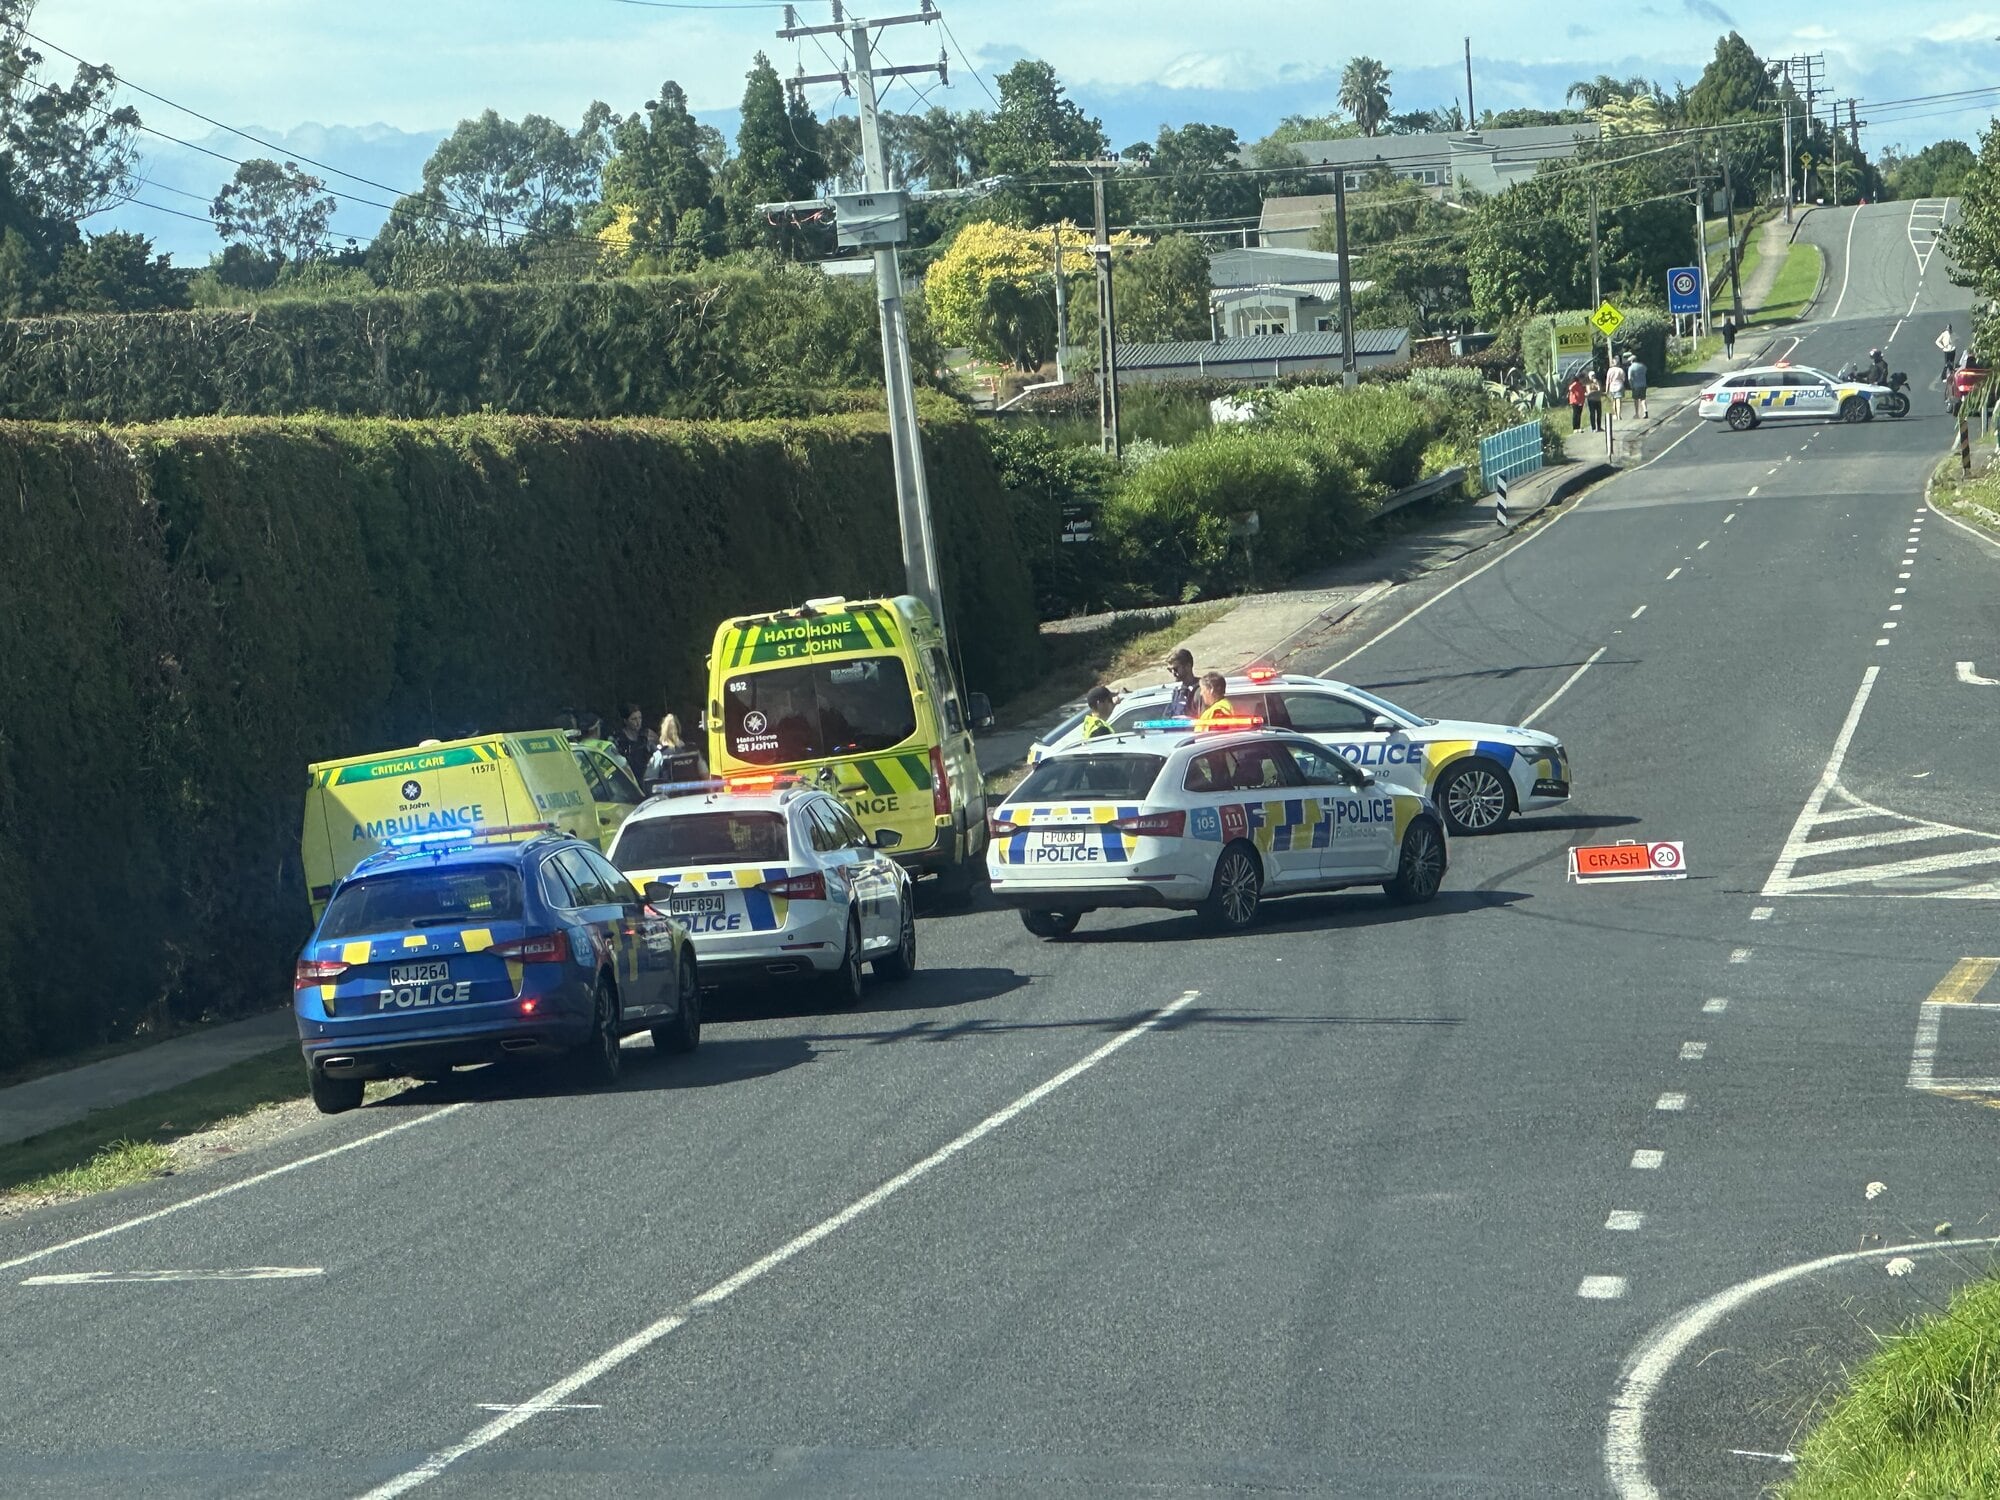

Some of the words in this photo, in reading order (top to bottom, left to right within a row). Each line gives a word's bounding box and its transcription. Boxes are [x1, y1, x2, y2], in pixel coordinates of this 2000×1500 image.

[1679, 280, 1691, 288] 50
[764, 626, 808, 643] HATO
[810, 621, 852, 637] HONE
[777, 645, 796, 657] ST
[801, 639, 843, 654] JOHN
[729, 681, 747, 692] 852
[737, 743, 750, 752] St
[750, 740, 779, 752] John
[371, 759, 417, 776] CRITICAL
[418, 755, 445, 767] CARE
[1336, 799, 1394, 824] POLICE
[352, 804, 484, 841] AMBULANCE
[1197, 816, 1215, 830] 105
[1225, 813, 1243, 827] 111
[1036, 847, 1099, 862] POLICE
[1589, 852, 1640, 867] CRASH
[1657, 851, 1675, 862] 20
[672, 897, 722, 914] QUF894
[391, 963, 448, 982] RJJ264
[379, 981, 472, 1010] POLICE
